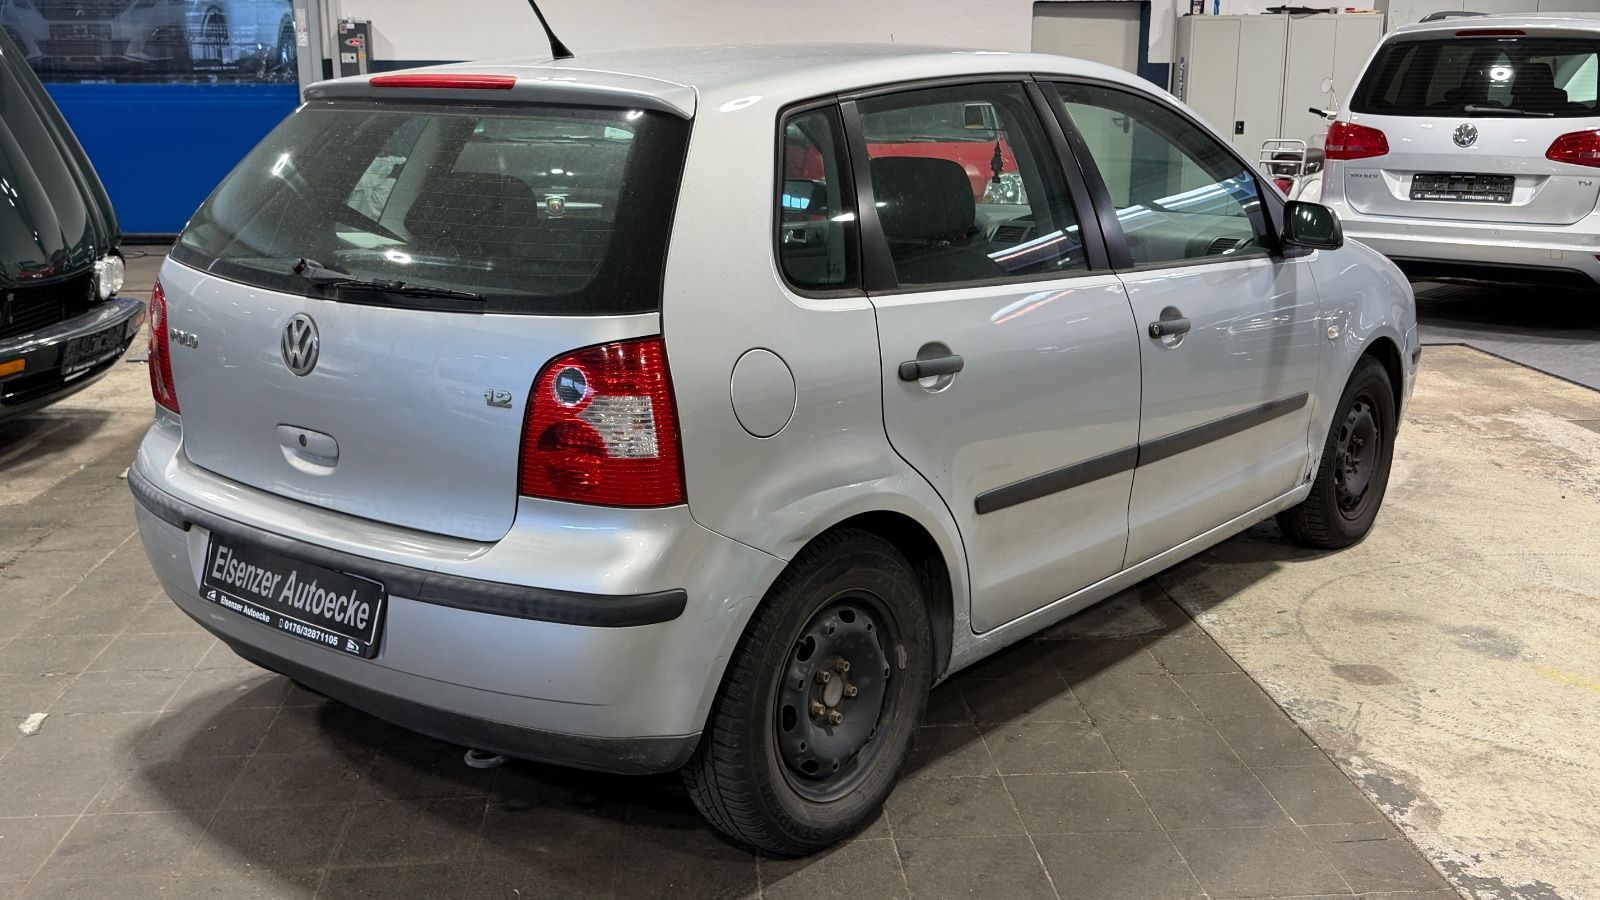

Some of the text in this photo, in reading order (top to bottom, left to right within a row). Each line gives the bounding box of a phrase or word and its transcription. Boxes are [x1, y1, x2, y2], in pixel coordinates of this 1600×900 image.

[171, 327, 198, 349] POLO
[281, 312, 319, 377] VW
[211, 545, 370, 630] Elsenzer Autoecke
[220, 594, 339, 646] Elsenzer Autoecke 0176/32871105
